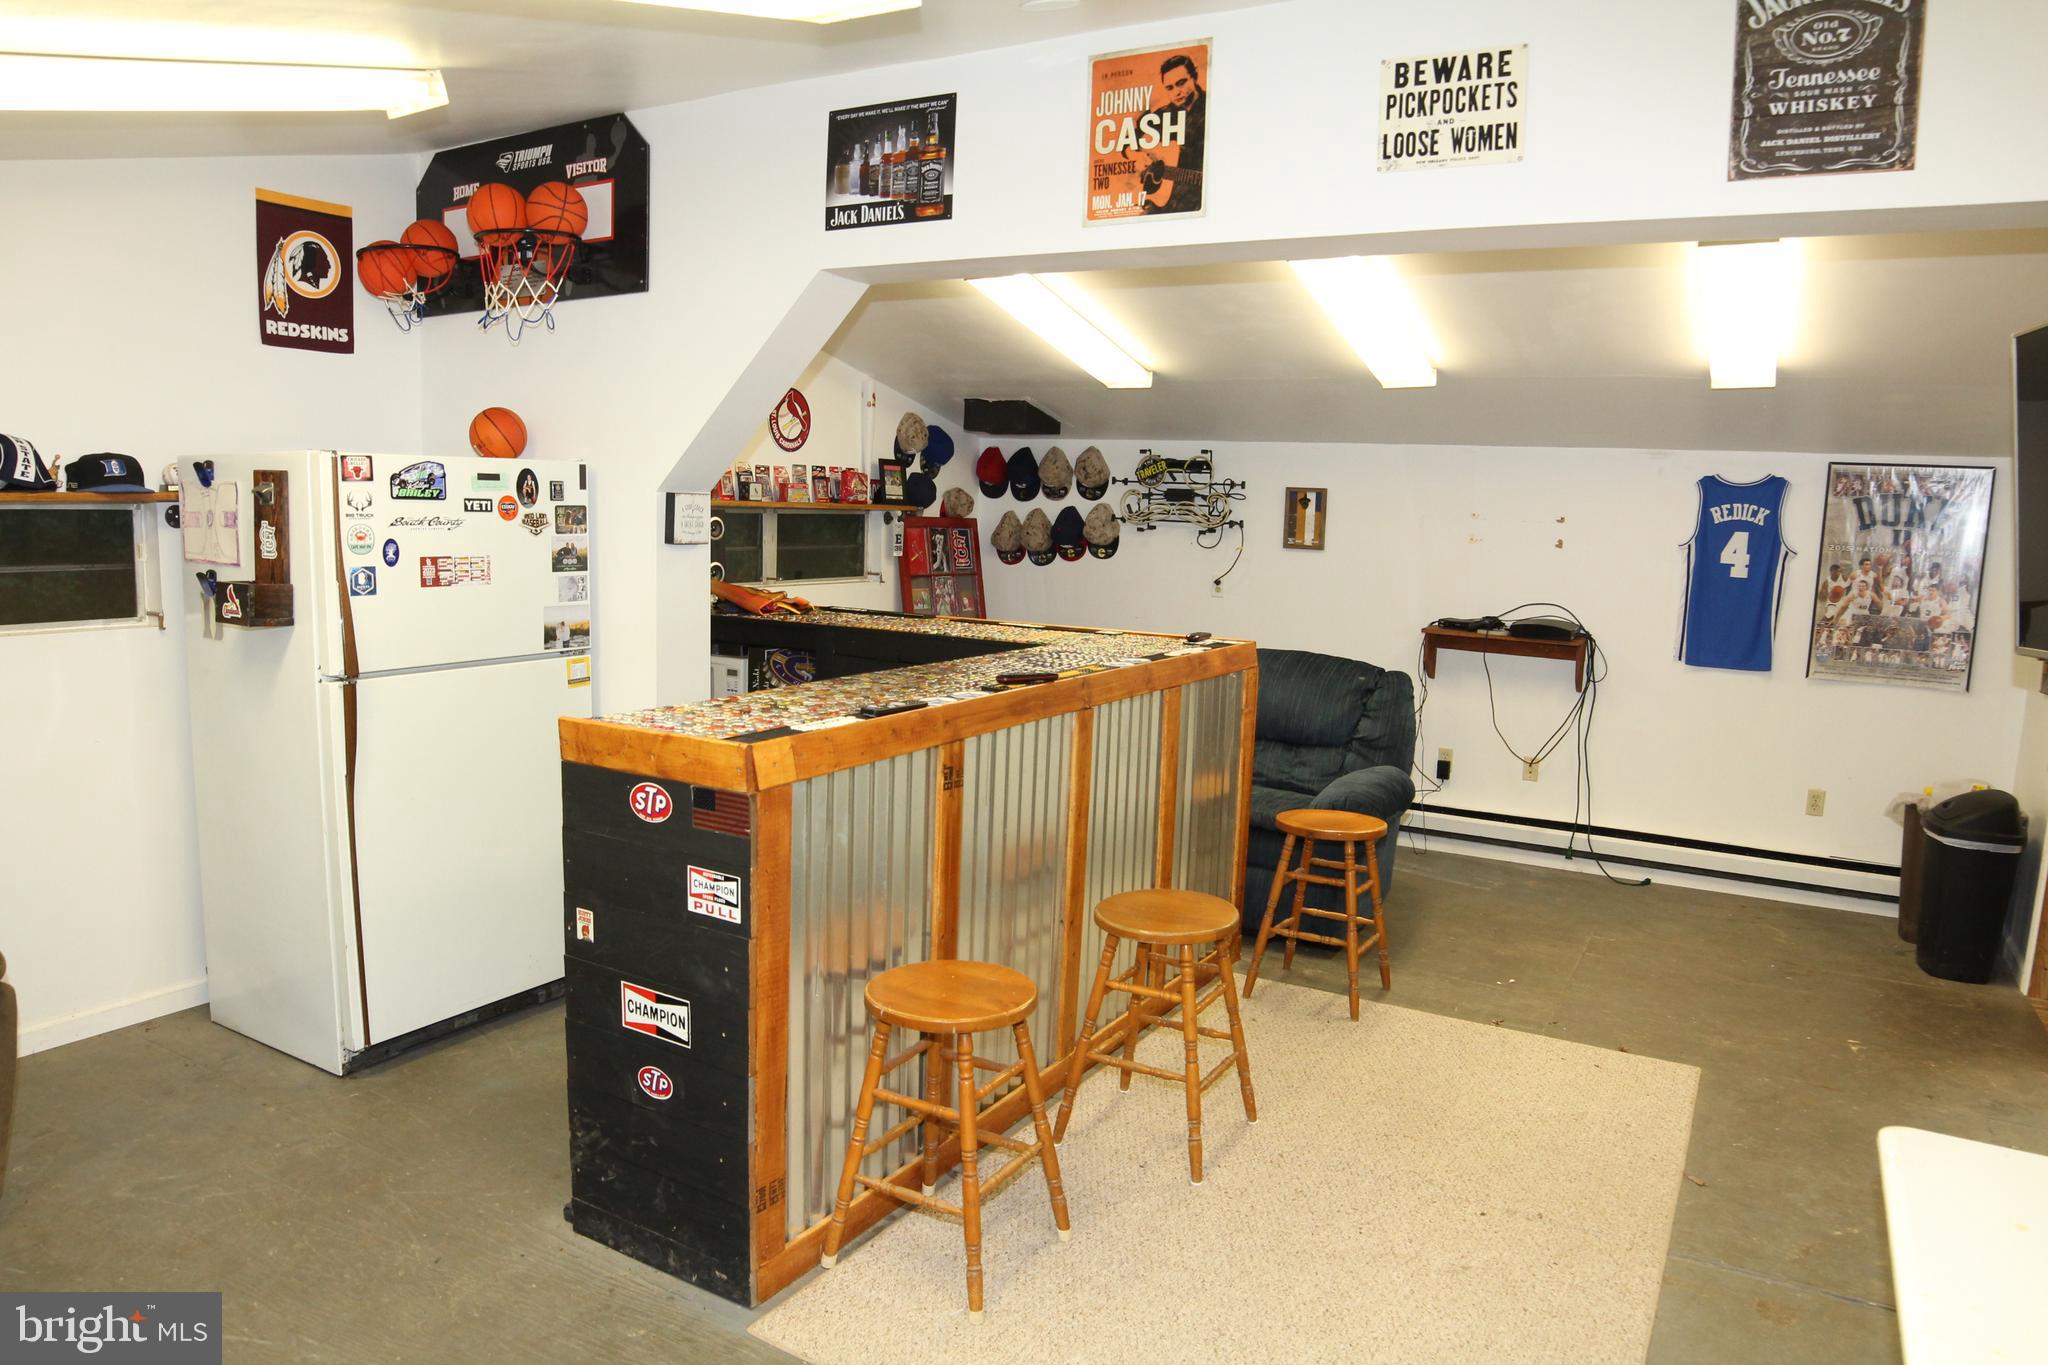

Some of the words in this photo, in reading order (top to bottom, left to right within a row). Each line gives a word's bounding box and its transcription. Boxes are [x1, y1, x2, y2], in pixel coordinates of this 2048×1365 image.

[1748, 0, 1822, 29] JA
[1394, 49, 1513, 89] BEWARE
[1768, 66, 1881, 90] Tennessee
[1096, 85, 1153, 117] JOHNNY
[1386, 81, 1518, 120] PICKPOCKETS
[1768, 93, 1878, 116] WHISKEY
[1095, 110, 1187, 155] CASH
[1437, 118, 1455, 126] AND
[1382, 129, 1440, 160] LOOSE
[1451, 122, 1518, 154] WOMEN
[514, 144, 553, 162] TRIUMPH
[512, 160, 536, 172] SPORTS
[565, 157, 607, 179] VISITOR
[1094, 160, 1136, 177] TENNESSEE
[1093, 177, 1110, 191] TWO
[1092, 194, 1113, 211] MON.
[1137, 191, 1147, 207] 17
[830, 207, 858, 227] JACK
[860, 202, 905, 224] DANIEL'S
[265, 319, 349, 343] REDSKINS
[1136, 461, 1168, 480] TRAVELER
[465, 500, 491, 511] YETI
[1710, 503, 1771, 526] REDICK
[1720, 531, 1751, 578] 4
[635, 786, 667, 815] STP
[693, 878, 735, 897] CHAMPION
[694, 900, 737, 920] PULL
[627, 999, 686, 1031] CHAMPION
[642, 1069, 669, 1091] STP
